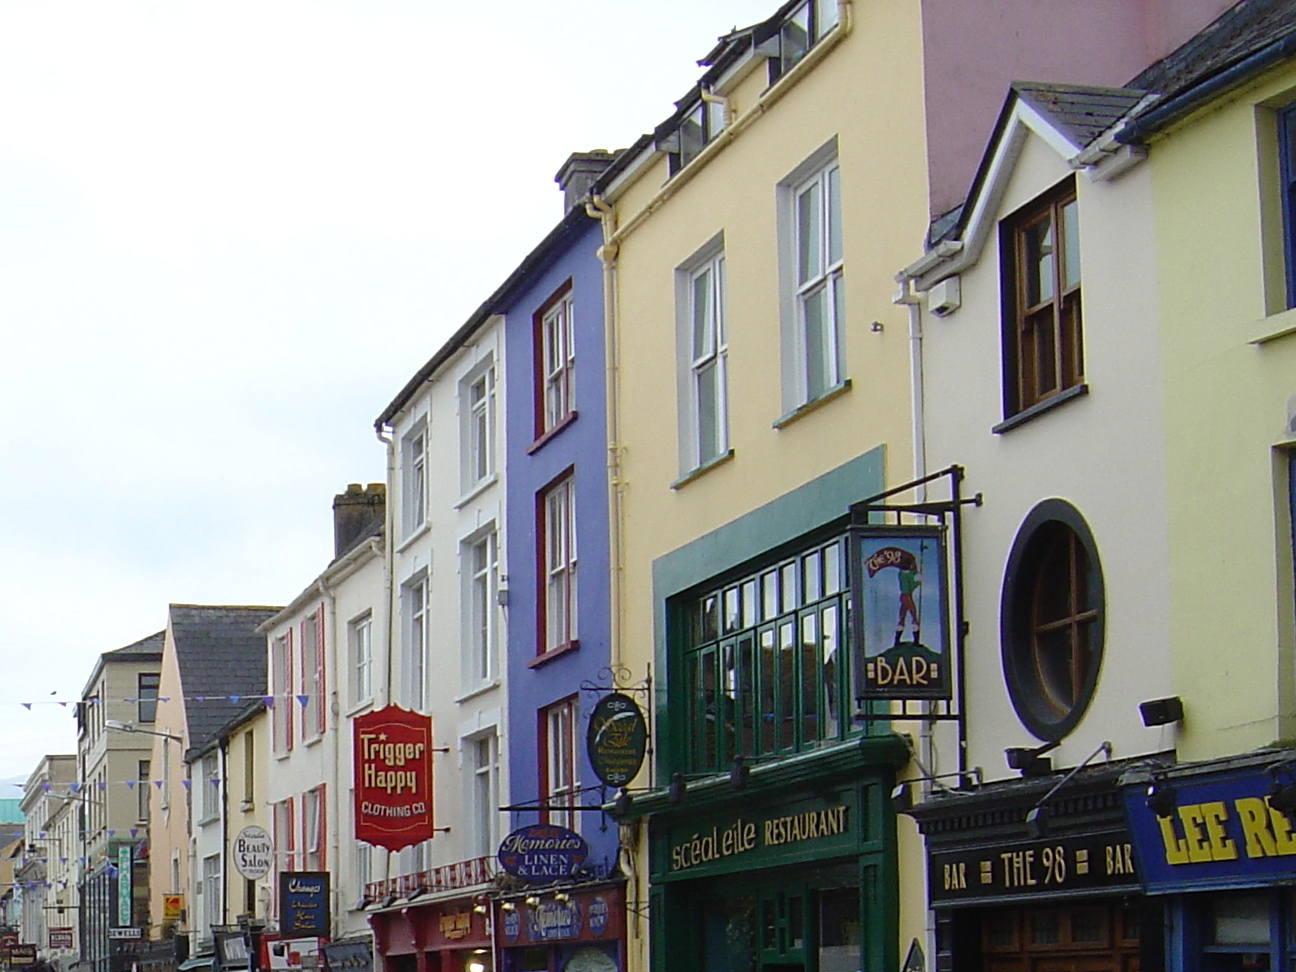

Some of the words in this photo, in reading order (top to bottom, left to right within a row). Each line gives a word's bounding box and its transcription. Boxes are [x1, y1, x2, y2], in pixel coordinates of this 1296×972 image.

[867, 554, 885, 571] The
[877, 656, 928, 685] BAR
[360, 734, 425, 766] Trigger
[364, 763, 416, 795] Happy
[361, 801, 411, 817] CLOTHING
[764, 805, 847, 846] RESTAURANT
[1156, 801, 1238, 865] LEE
[501, 834, 582, 855] Memories
[524, 853, 569, 866] LINEN
[517, 865, 528, 876] &
[531, 864, 568, 876] LACE
[943, 862, 967, 890] BAR
[1000, 850, 1037, 888] THE
[1041, 845, 1067, 885] 98
[1105, 843, 1135, 876] BAR
[119, 856, 130, 925] PHARMACY
